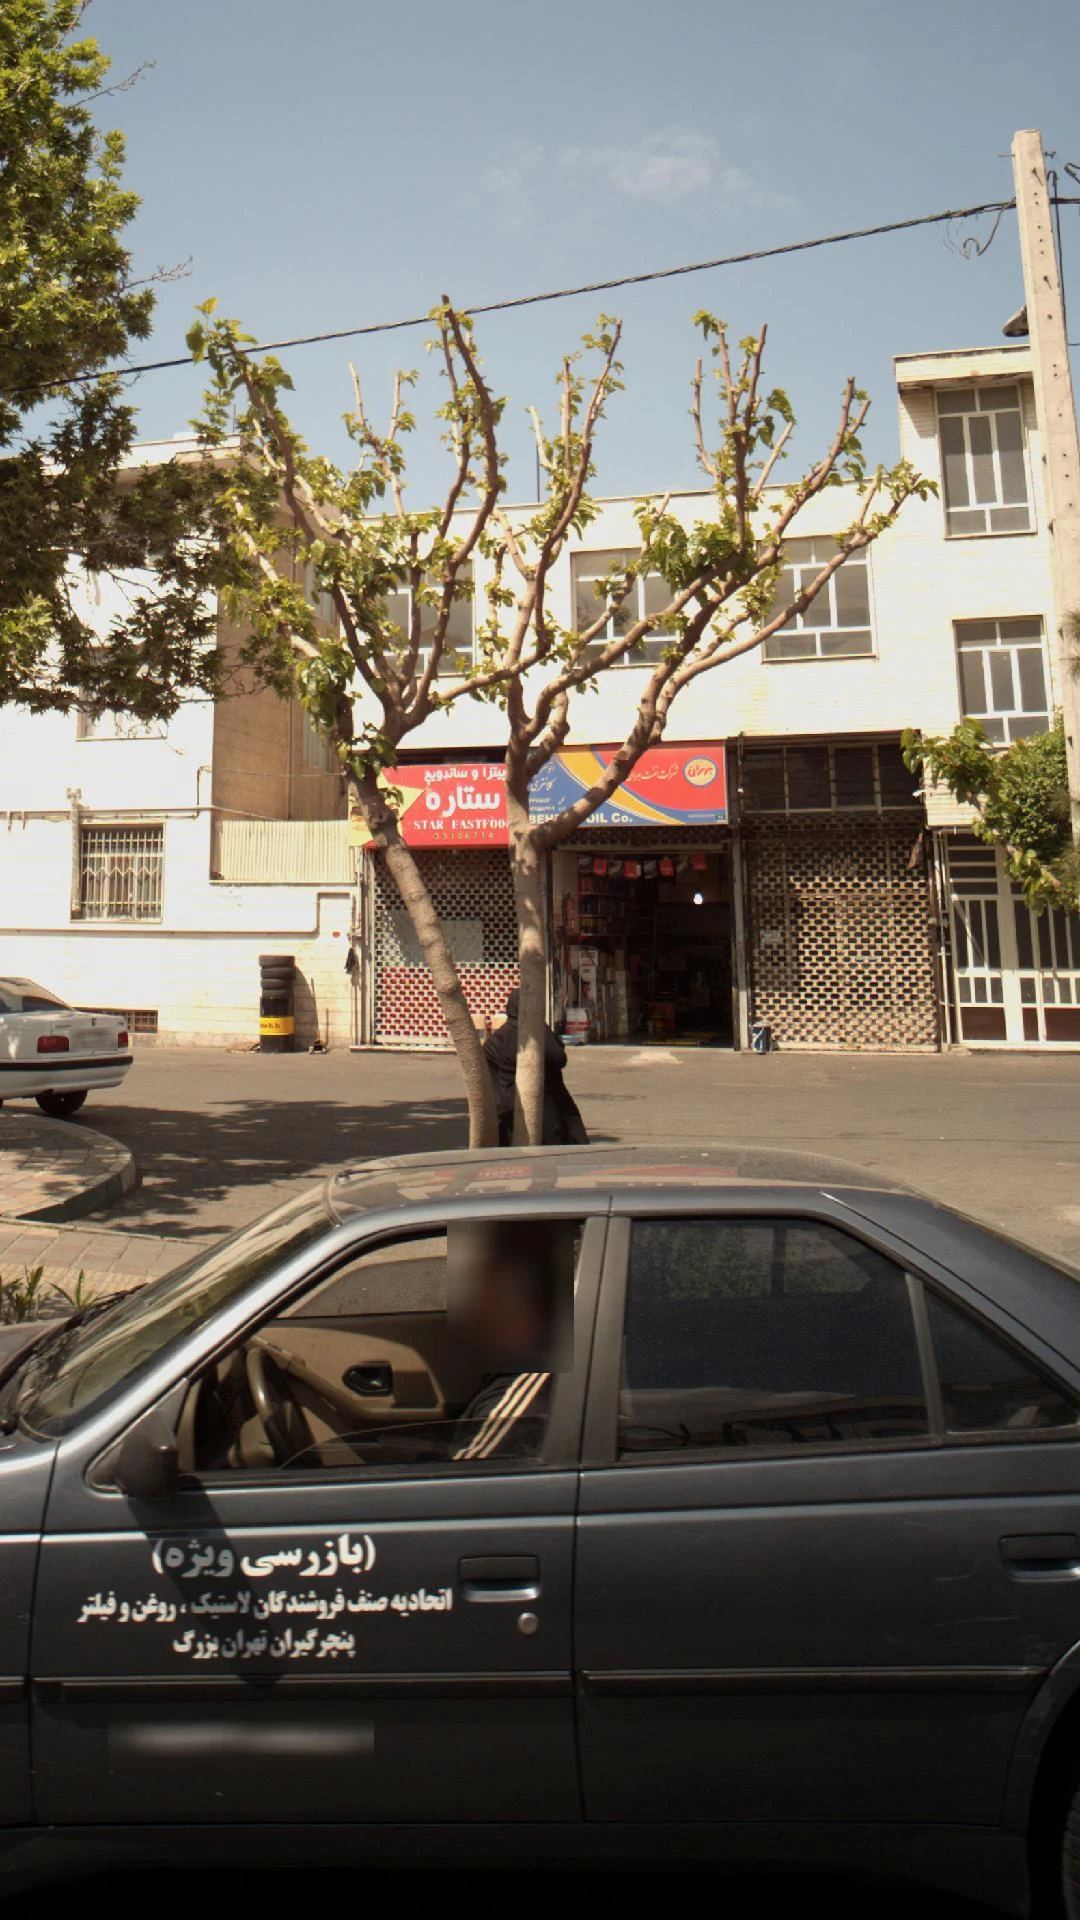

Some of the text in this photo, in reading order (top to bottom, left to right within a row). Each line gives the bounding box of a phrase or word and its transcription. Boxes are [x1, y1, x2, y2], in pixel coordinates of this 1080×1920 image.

[424, 767, 468, 785] ساندویچ
[471, 768, 479, 781] و
[425, 785, 501, 818] ستاره
[413, 819, 444, 830] STAR
[76, 1590, 117, 1622] فیلتر
[117, 1601, 130, 1622] و
[131, 1593, 177, 1622] روغن
[190, 1591, 251, 1619] لاستیک
[254, 1588, 345, 1620] فروشندگان
[347, 1590, 389, 1612] صنف
[390, 1588, 453, 1617] اتحادیه
[173, 1629, 220, 1658] بزرگ
[221, 1629, 268, 1658] تهران
